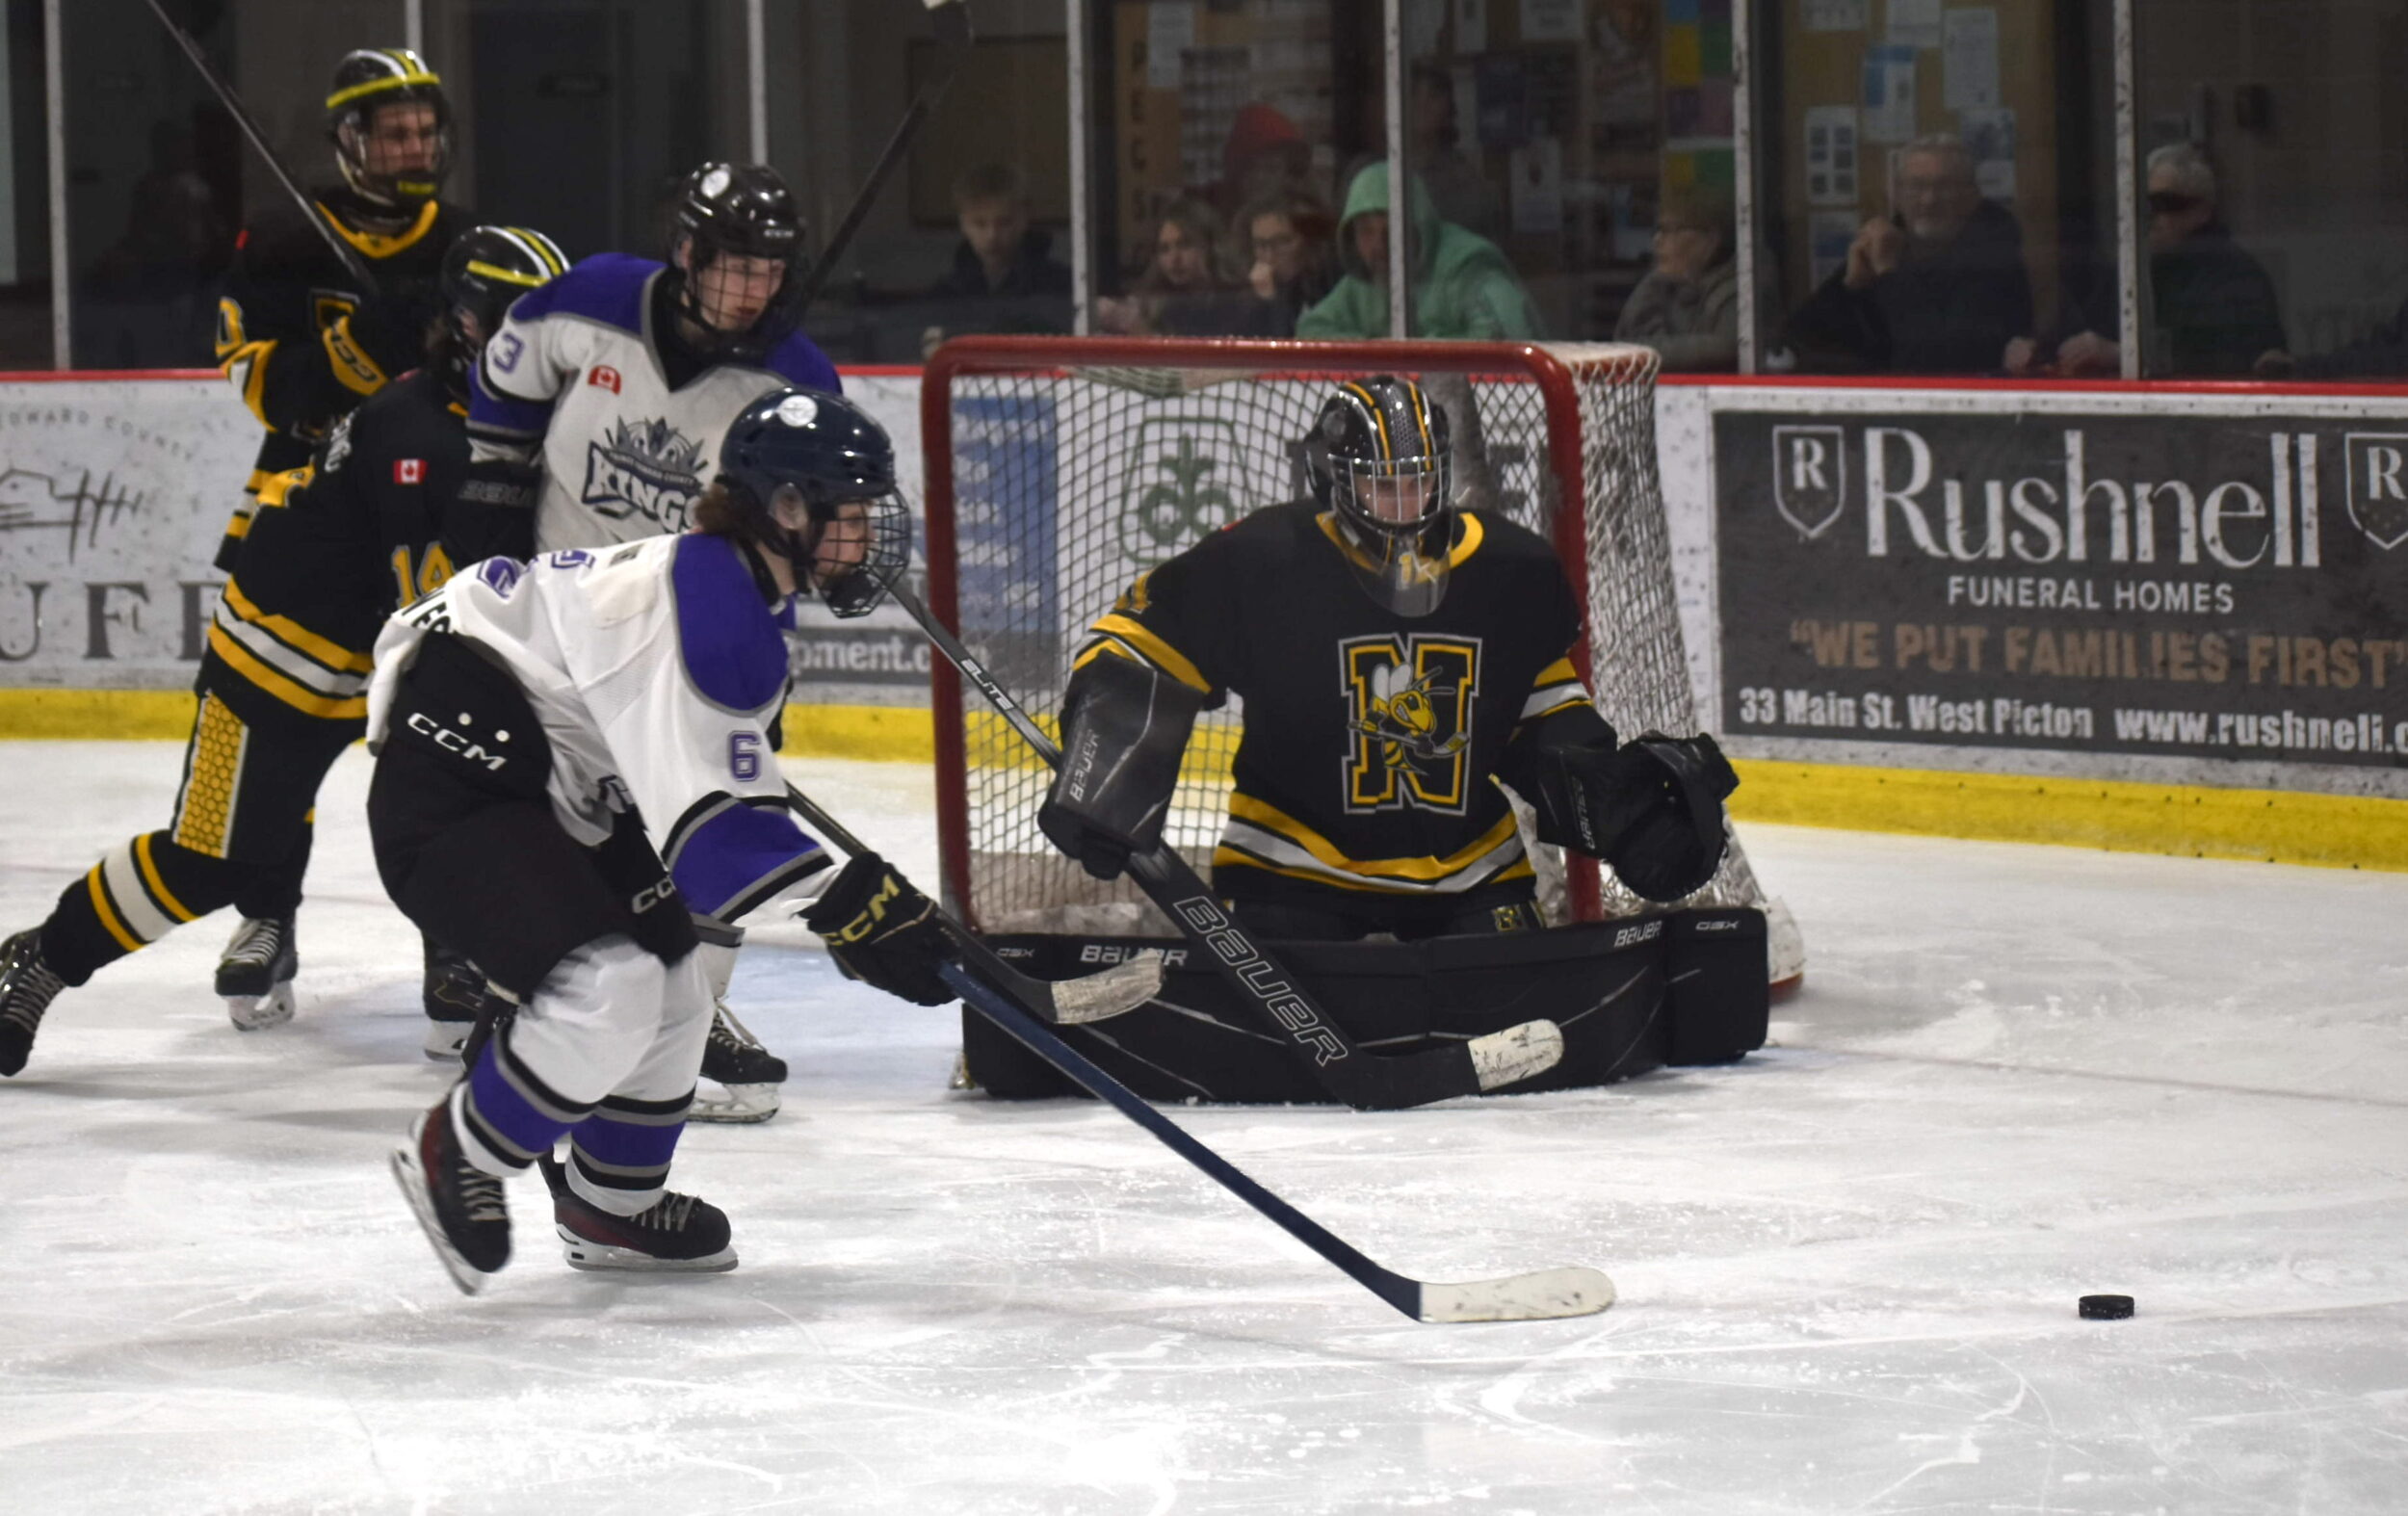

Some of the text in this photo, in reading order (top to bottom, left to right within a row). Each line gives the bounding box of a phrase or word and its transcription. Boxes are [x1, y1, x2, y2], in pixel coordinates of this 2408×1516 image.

[492, 332, 525, 373] 3
[0, 406, 91, 428] DWARD
[1792, 438, 1827, 490] R
[2367, 446, 2408, 500] R
[1865, 427, 2320, 569] Rushnell
[391, 541, 456, 611] 14
[1948, 575, 2235, 614] FUNERAL HOMES
[1895, 624, 1988, 673] PUT
[2004, 626, 2230, 684] FAMILIES
[961, 658, 1014, 712] ELITE
[1338, 632, 1483, 817] N
[1739, 686, 1776, 724] 33
[1784, 689, 1857, 728] Main
[1862, 692, 1902, 730] St.
[1907, 694, 1987, 734] West
[1993, 697, 2094, 740] Picton
[407, 713, 508, 771] CCM
[727, 730, 762, 782] 6
[1068, 727, 1101, 802] BAUER
[632, 877, 678, 914] CC
[819, 874, 902, 946] CCM
[1613, 920, 1663, 949] BAUER
[1172, 895, 1349, 1067] BAUER
